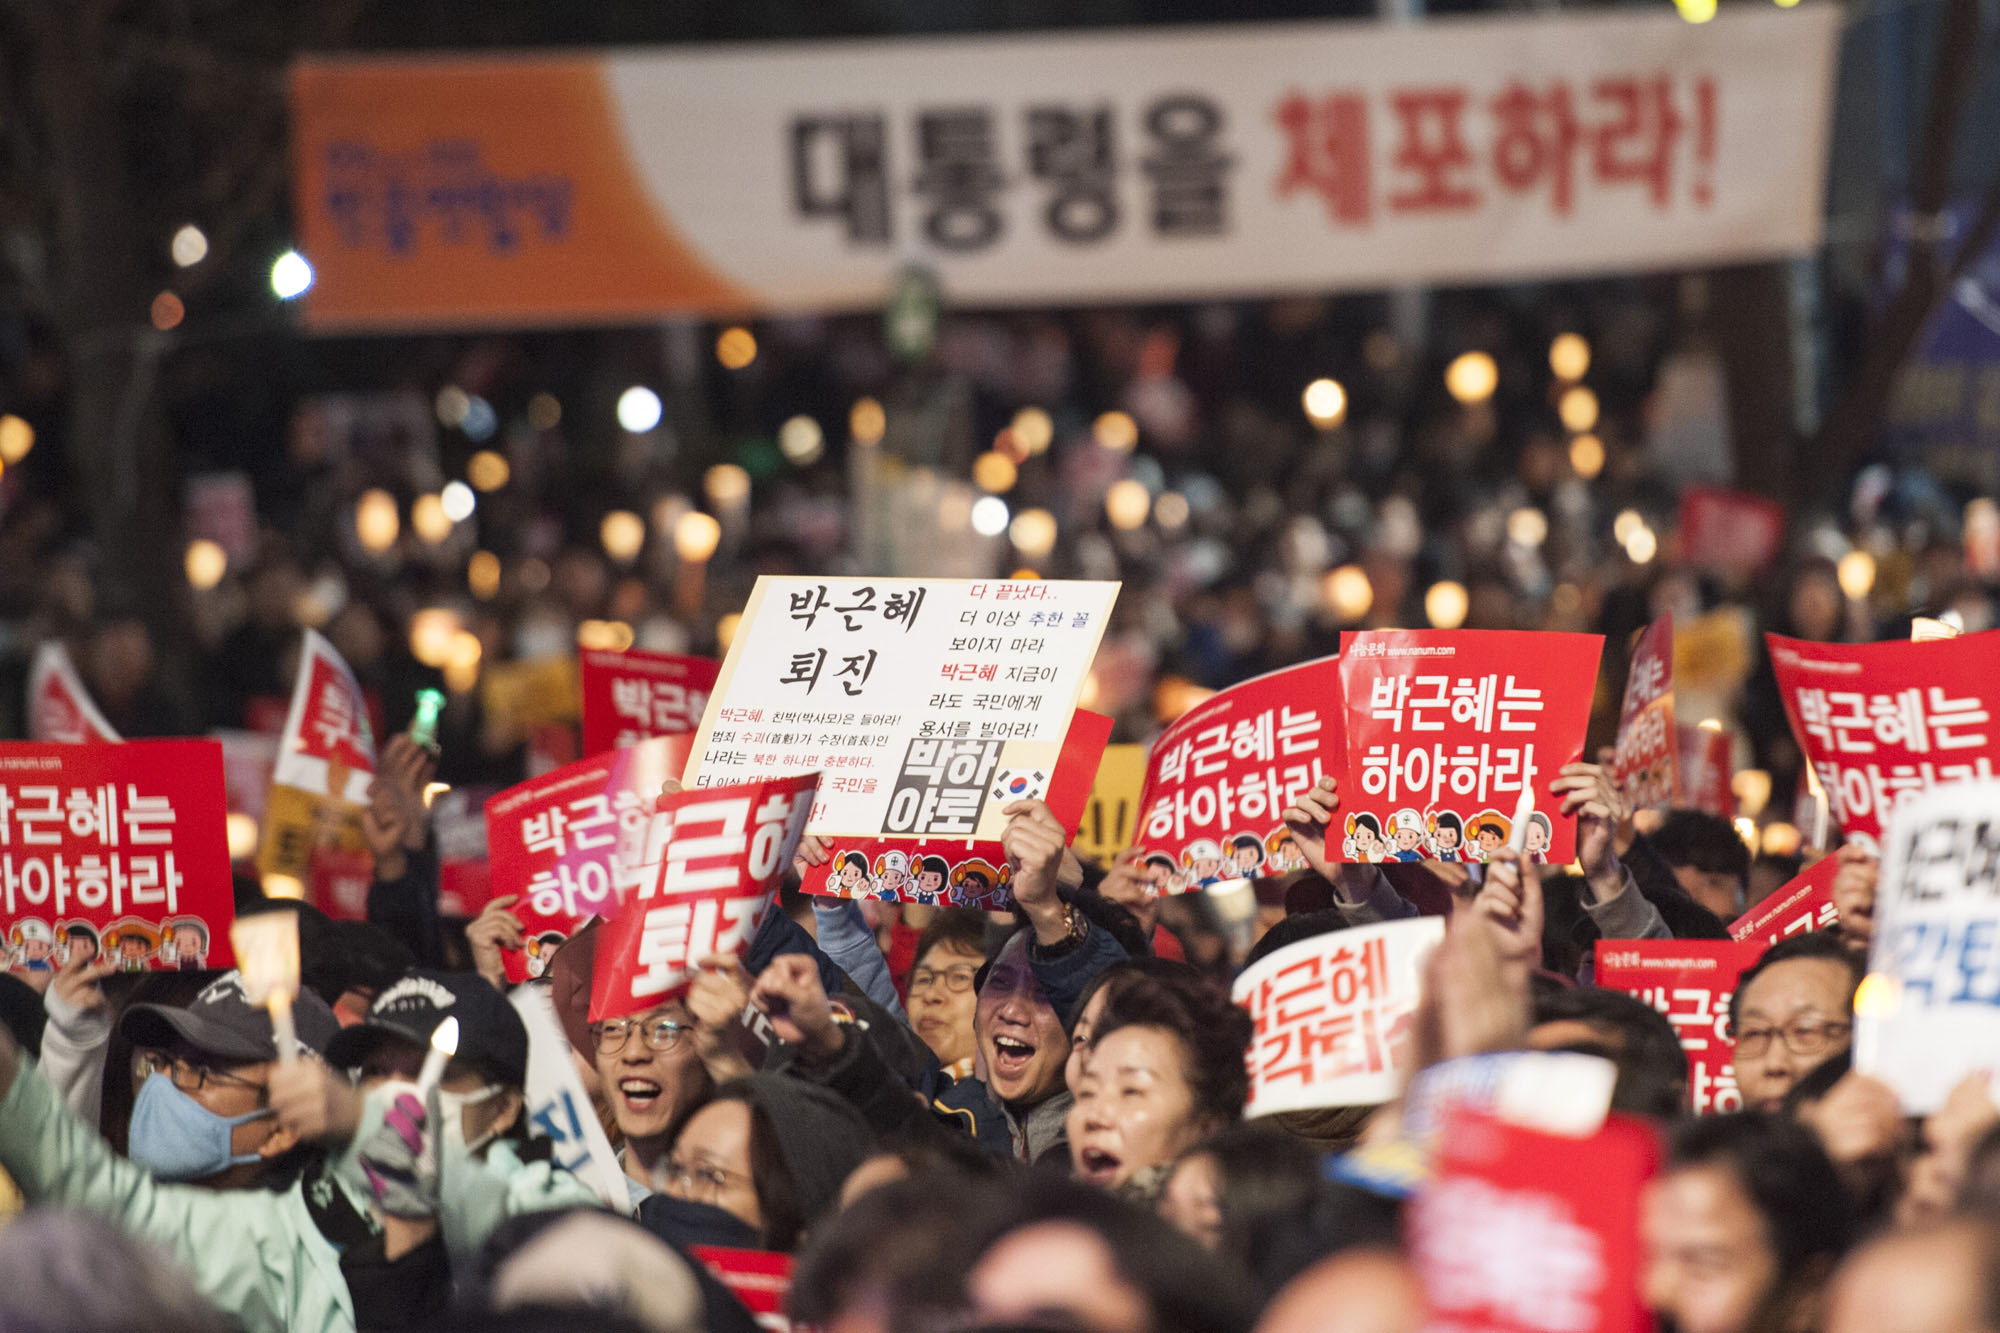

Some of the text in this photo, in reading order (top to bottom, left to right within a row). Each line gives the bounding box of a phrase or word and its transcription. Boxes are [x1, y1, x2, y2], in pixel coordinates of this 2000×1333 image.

[788, 73, 1720, 252] 대통령을 체포하라!
[970, 584, 987, 599] 다
[790, 585, 927, 633] 박근혜
[960, 610, 1089, 628] 더 이상 추한 꼴
[949, 636, 1045, 653] 보이지 마라
[1387, 646, 1456, 656] www.nanum.com
[941, 664, 1058, 682] 박근혜 지금이
[929, 693, 1042, 711] 라도 국민에게
[1370, 674, 1545, 734] 박근혜는
[772, 711, 855, 726] 친박(박사모)은
[860, 713, 902, 726] 들어라!
[1797, 686, 1989, 753] 박근혜는
[711, 731, 736, 743] 범죄
[919, 720, 1038, 739] 용서를 빌어라!
[1158, 705, 1321, 785] 박근혜는
[704, 750, 875, 768] 나라는 북한 하나면 충분하다.
[901, 738, 999, 785] 박하
[1361, 743, 1540, 803] 하야하라
[832, 776, 877, 793] 국민을
[887, 786, 983, 833] 야로
